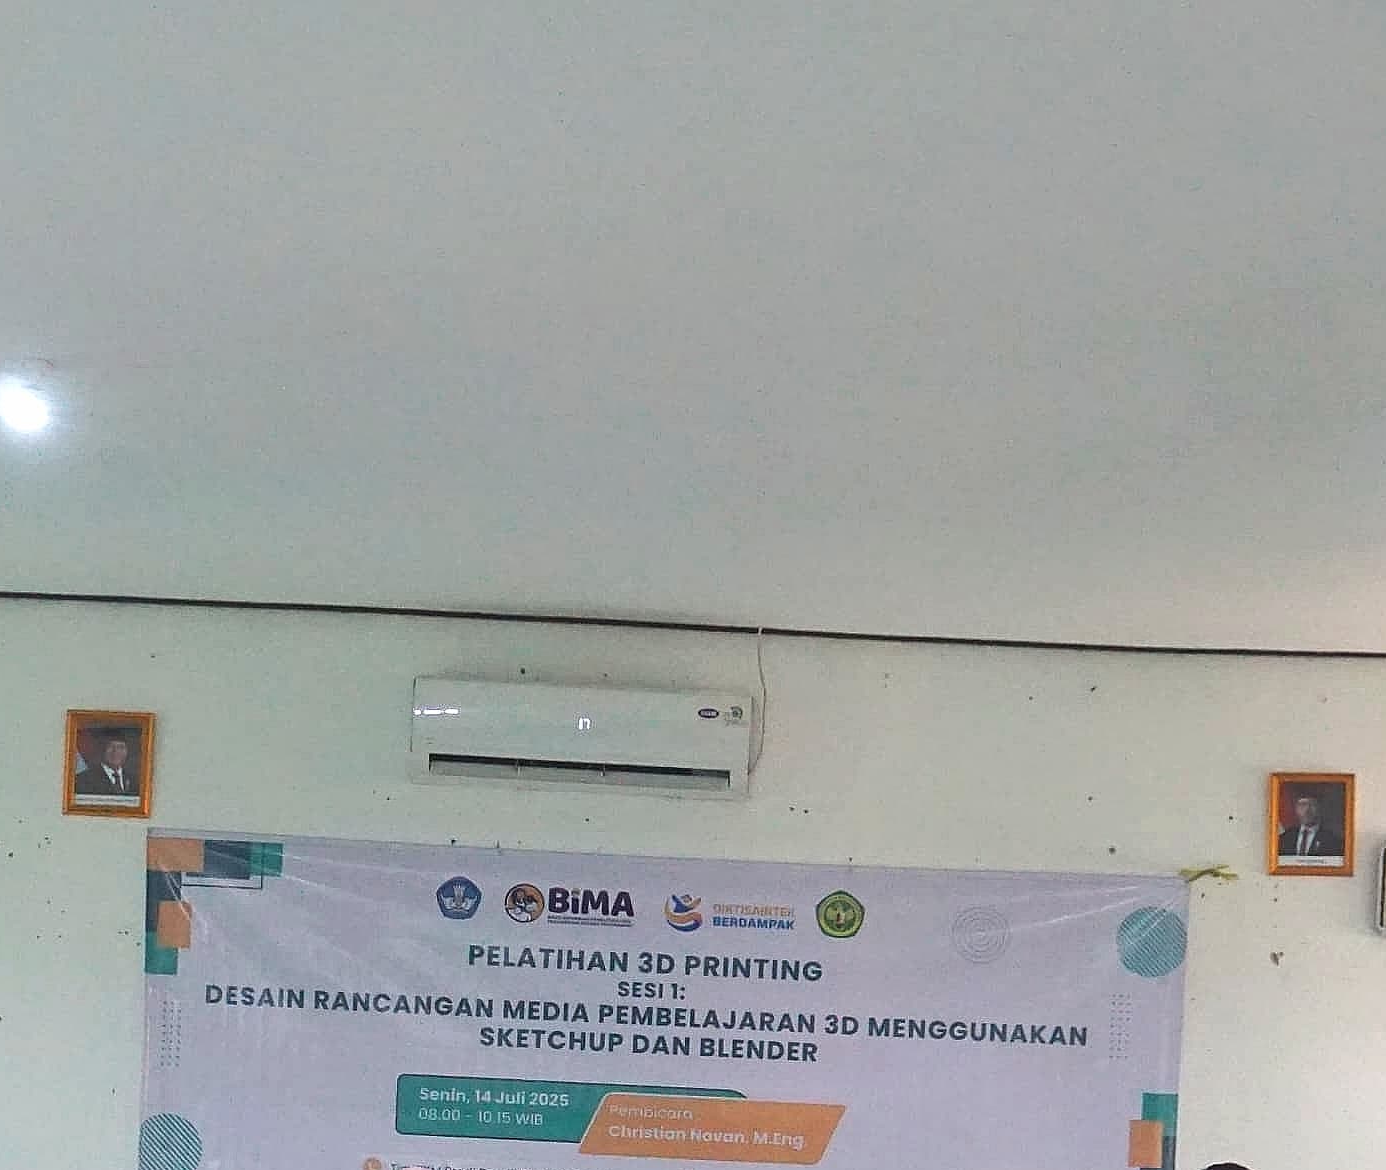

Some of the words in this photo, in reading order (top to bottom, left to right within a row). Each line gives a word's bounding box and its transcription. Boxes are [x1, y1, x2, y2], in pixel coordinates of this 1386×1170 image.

[548, 887, 634, 917] BiMA
[713, 916, 795, 930] BERDAMPAK
[469, 944, 628, 973] PELATIHAN
[638, 952, 675, 974] 3D
[685, 955, 823, 981] PRINTING
[618, 982, 664, 998] SESI
[671, 983, 686, 1000] 1:
[205, 984, 305, 1008] DESAIN
[314, 991, 493, 1018] RANCANGAN
[503, 1000, 589, 1023] MEDIA
[599, 1005, 815, 1034] PEMBELAJARAN
[824, 1014, 858, 1036] 3D
[868, 1017, 1088, 1046] MENGGUNAKAN
[480, 1027, 623, 1052] SKETCHUP
[632, 1034, 690, 1056] DAN
[699, 1038, 818, 1062] BLENDER
[419, 1087, 470, 1104] Senin,
[475, 1089, 491, 1104] 14
[495, 1090, 526, 1105] Juli
[529, 1092, 569, 1107] 2025
[418, 1107, 461, 1121] 08.00
[516, 1113, 543, 1126] WIB
[608, 1125, 687, 1142] Christian
